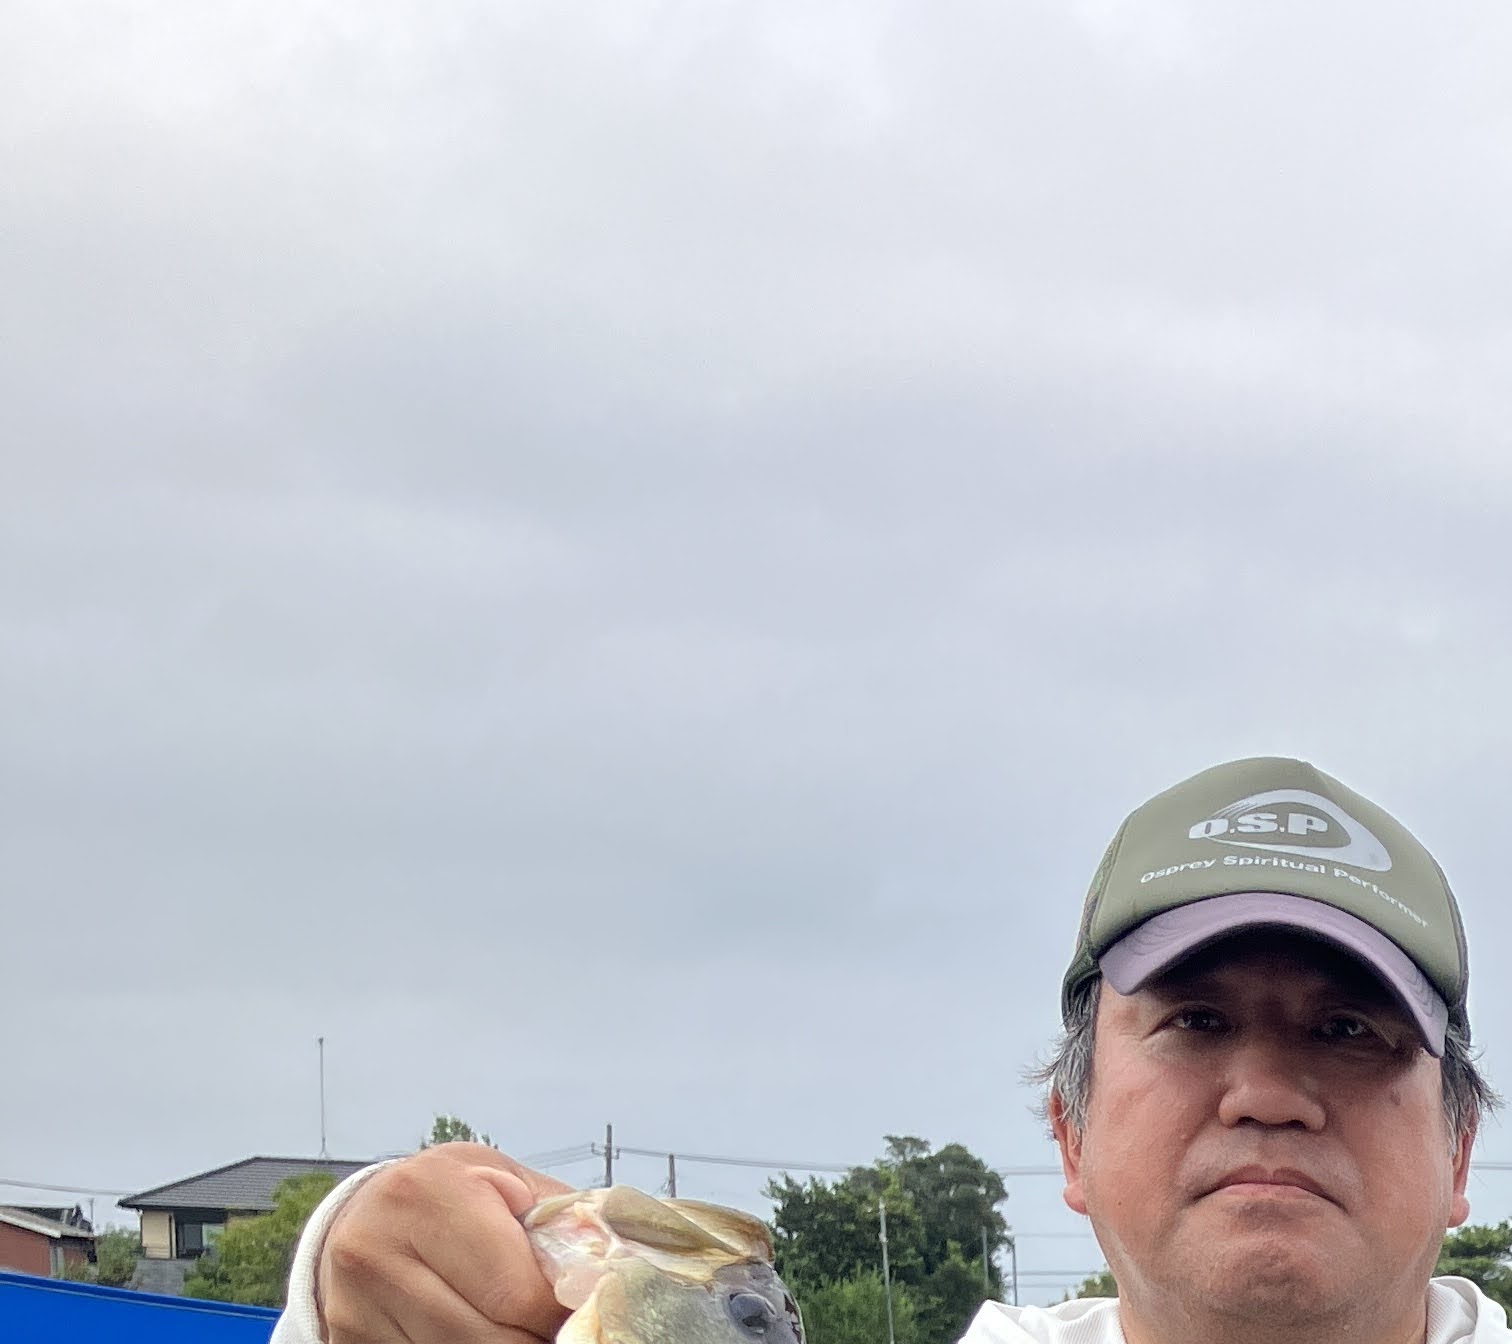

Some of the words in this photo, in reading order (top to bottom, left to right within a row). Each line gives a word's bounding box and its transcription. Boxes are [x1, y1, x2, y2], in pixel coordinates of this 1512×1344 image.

[1140, 856, 1216, 884] Osprey
[1223, 855, 1326, 874] Spiritual
[1333, 868, 1430, 930] Performer
